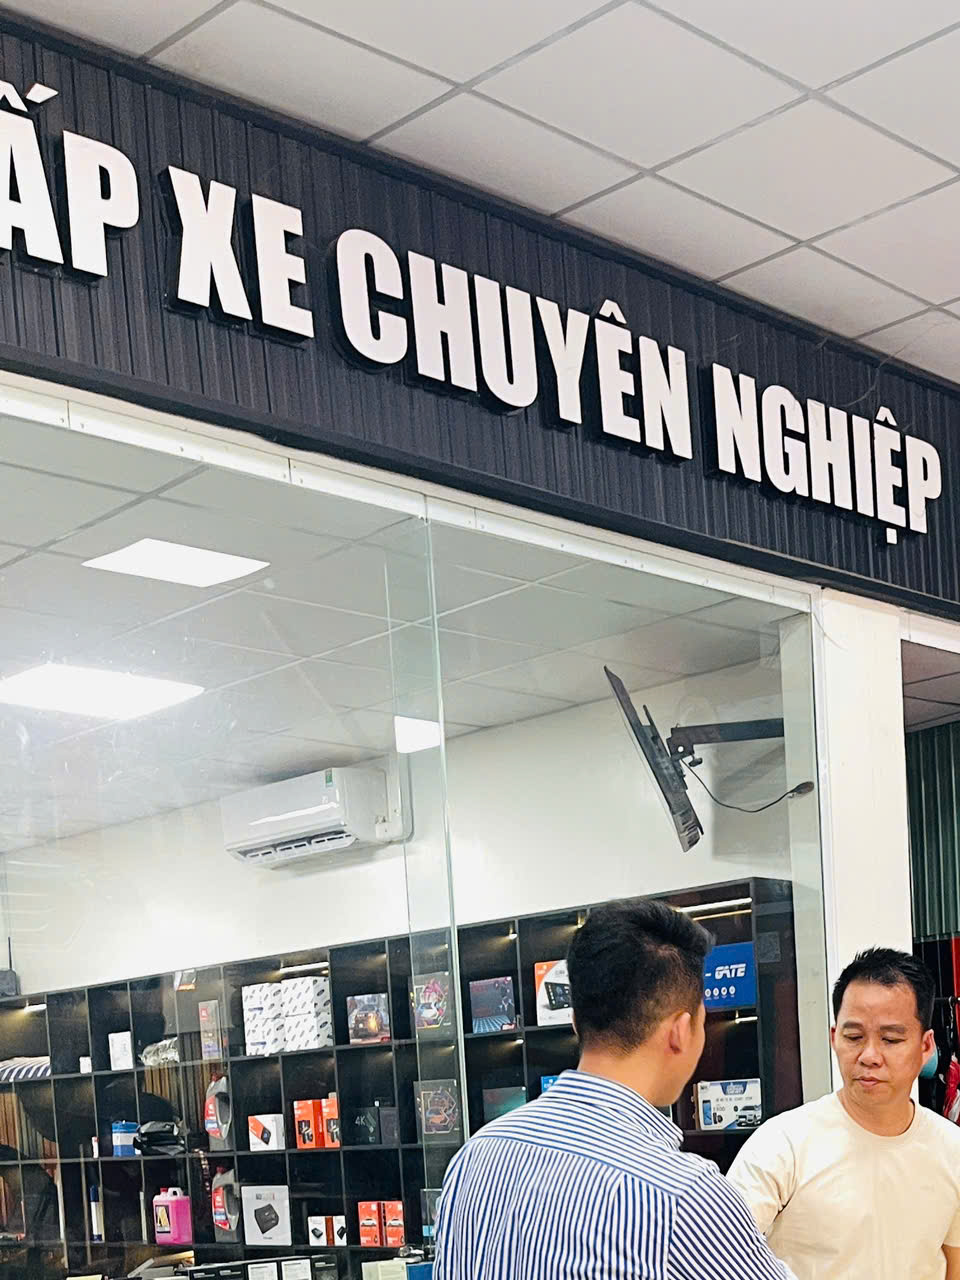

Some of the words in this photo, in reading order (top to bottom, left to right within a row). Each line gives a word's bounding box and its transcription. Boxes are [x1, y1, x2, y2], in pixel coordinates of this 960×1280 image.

[168, 165, 314, 338] XE
[336, 229, 693, 459] CHUYÊN
[712, 362, 942, 545] NGHIỆP
